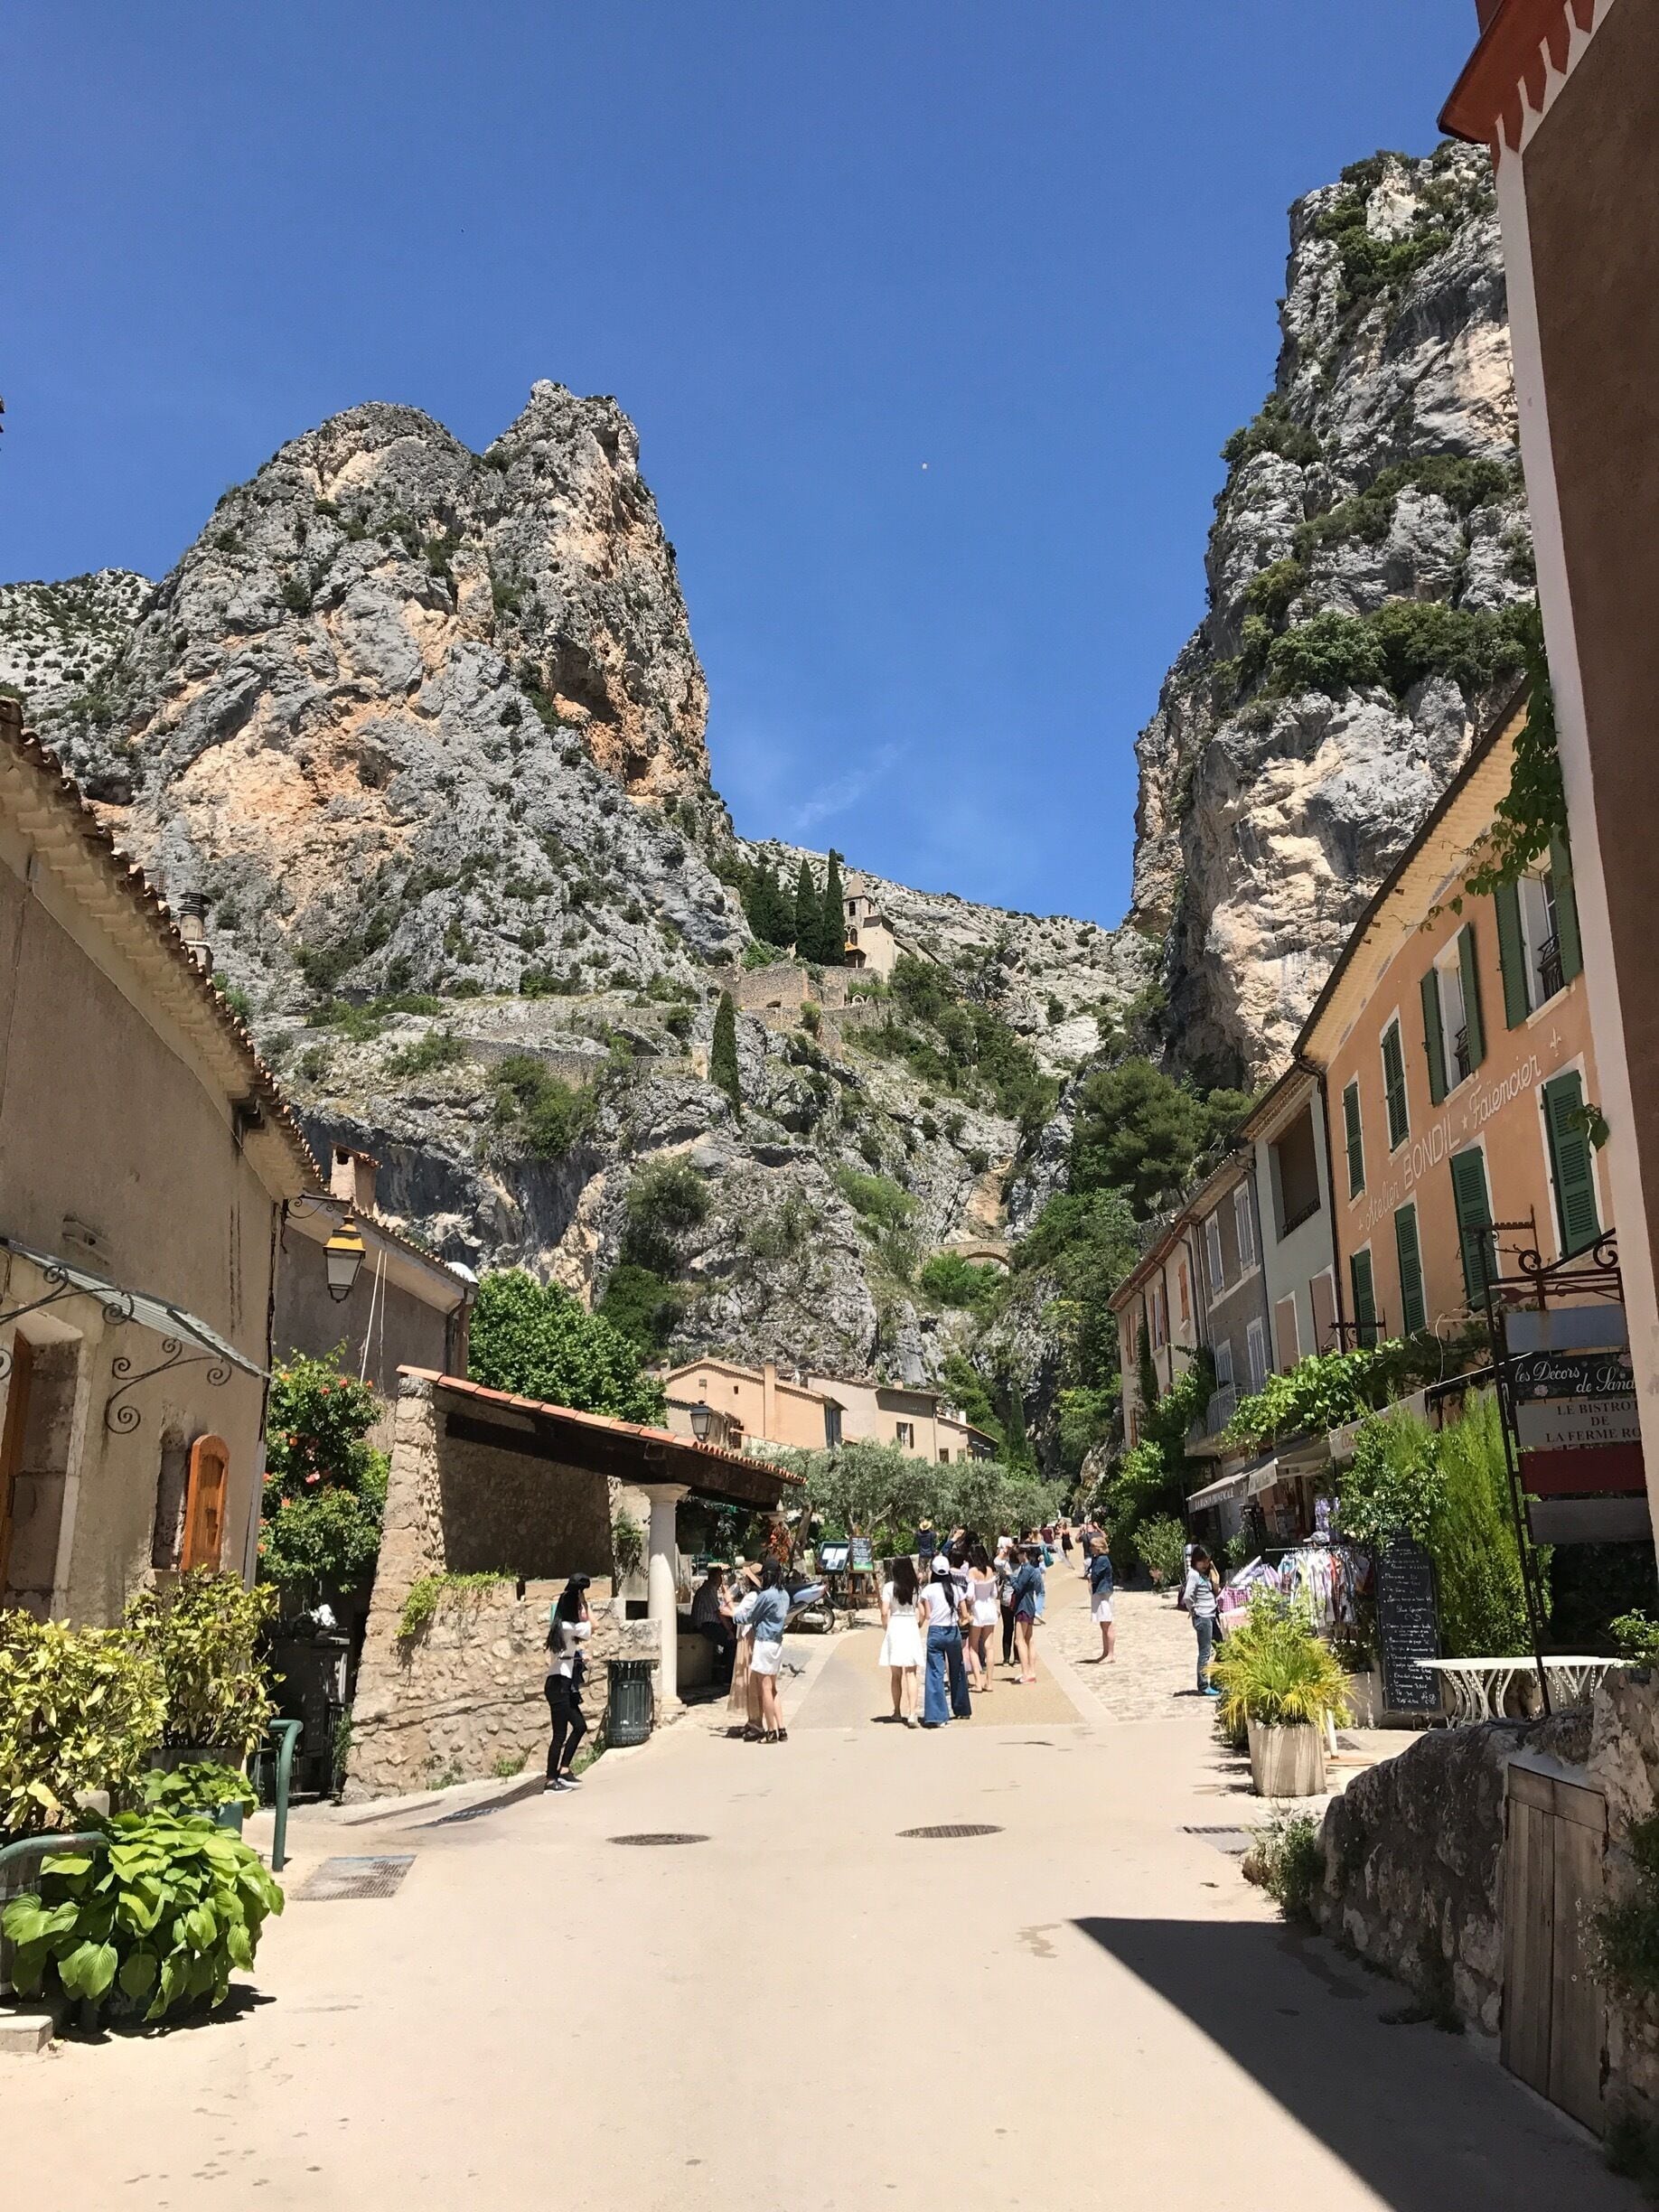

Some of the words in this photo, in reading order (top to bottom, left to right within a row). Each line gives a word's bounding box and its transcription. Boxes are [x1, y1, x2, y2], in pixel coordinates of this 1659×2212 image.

[1402, 1113, 1461, 1191] BONDIL
[1532, 1360, 1581, 1382] Décors
[1575, 1373, 1592, 1393] de
[1556, 1405, 1576, 1416] LE
[1590, 1415, 1610, 1427] DE
[1546, 1431, 1566, 1443] LA
[1568, 1428, 1618, 1442] FERME
